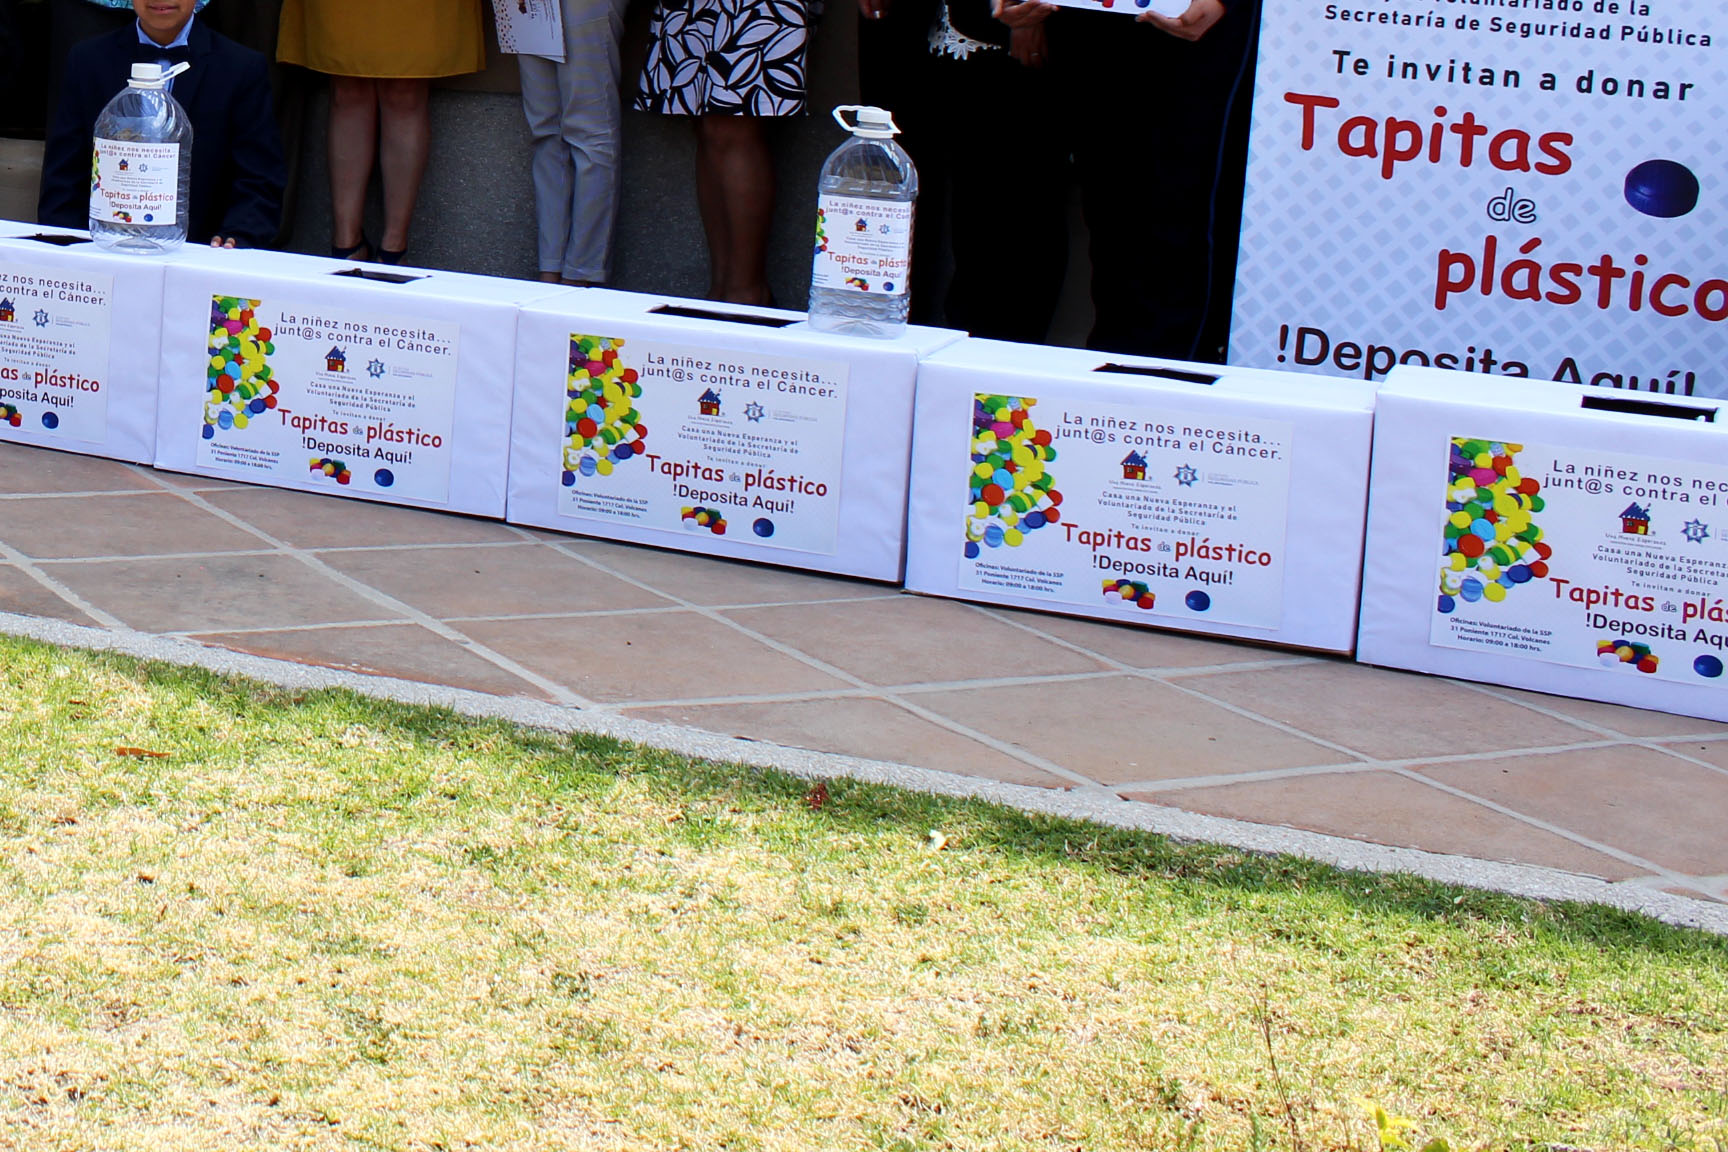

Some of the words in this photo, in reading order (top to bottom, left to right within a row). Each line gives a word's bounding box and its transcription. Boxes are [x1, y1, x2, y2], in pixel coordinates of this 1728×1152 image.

[1593, 0, 1620, 15] de
[1629, 0, 1650, 17] la
[1325, 4, 1445, 29] Secretaría
[1454, 14, 1480, 31] de
[1489, 17, 1611, 41] Seguridad
[1620, 25, 1712, 47] Pública
[1332, 49, 1370, 76] Te
[1387, 54, 1521, 88] invitan
[1539, 71, 1557, 90] a
[1576, 70, 1695, 101] donar
[1283, 91, 1574, 180] Tapitas
[1486, 187, 1537, 224] de
[273, 323, 322, 340] junt@s
[327, 332, 372, 346] contra
[379, 337, 391, 348] el
[397, 337, 451, 356] Cáncer.
[281, 312, 296, 324] La
[302, 316, 338, 329] niñez
[344, 323, 368, 333] nos
[374, 326, 450, 343] necesita...
[34, 365, 99, 392] plástico
[41, 392, 74, 408] Aquí!
[277, 408, 348, 435] Tapitas
[367, 420, 442, 448] plástico
[1055, 425, 1116, 444] junt@s
[1123, 435, 1181, 449] contra
[1189, 440, 1204, 452] el
[1212, 439, 1281, 460] Cáncer.
[1064, 412, 1083, 425] La
[1090, 416, 1137, 431] niñez
[1145, 423, 1175, 435] nos
[1183, 427, 1280, 446] necesita...
[302, 436, 370, 458] !Deposita
[374, 447, 412, 465] Aquí!
[645, 454, 724, 482] Tapitas
[744, 469, 827, 497] plástico
[1543, 473, 1613, 495] junt@s
[1623, 486, 1690, 503] contra
[1699, 493, 1716, 506] el
[1553, 460, 1575, 474] La
[1585, 465, 1638, 482] niñez
[1647, 474, 1682, 487] nos
[673, 483, 748, 507] !Deposita
[752, 495, 794, 514] Aquí!
[1061, 522, 1151, 552] Tapitas
[1175, 537, 1271, 566] plástico
[1093, 554, 1179, 578] !Deposita
[1184, 566, 1233, 586] Aquí!
[1549, 577, 1654, 612] Tapitas
[1586, 612, 1686, 641] !Deposita
